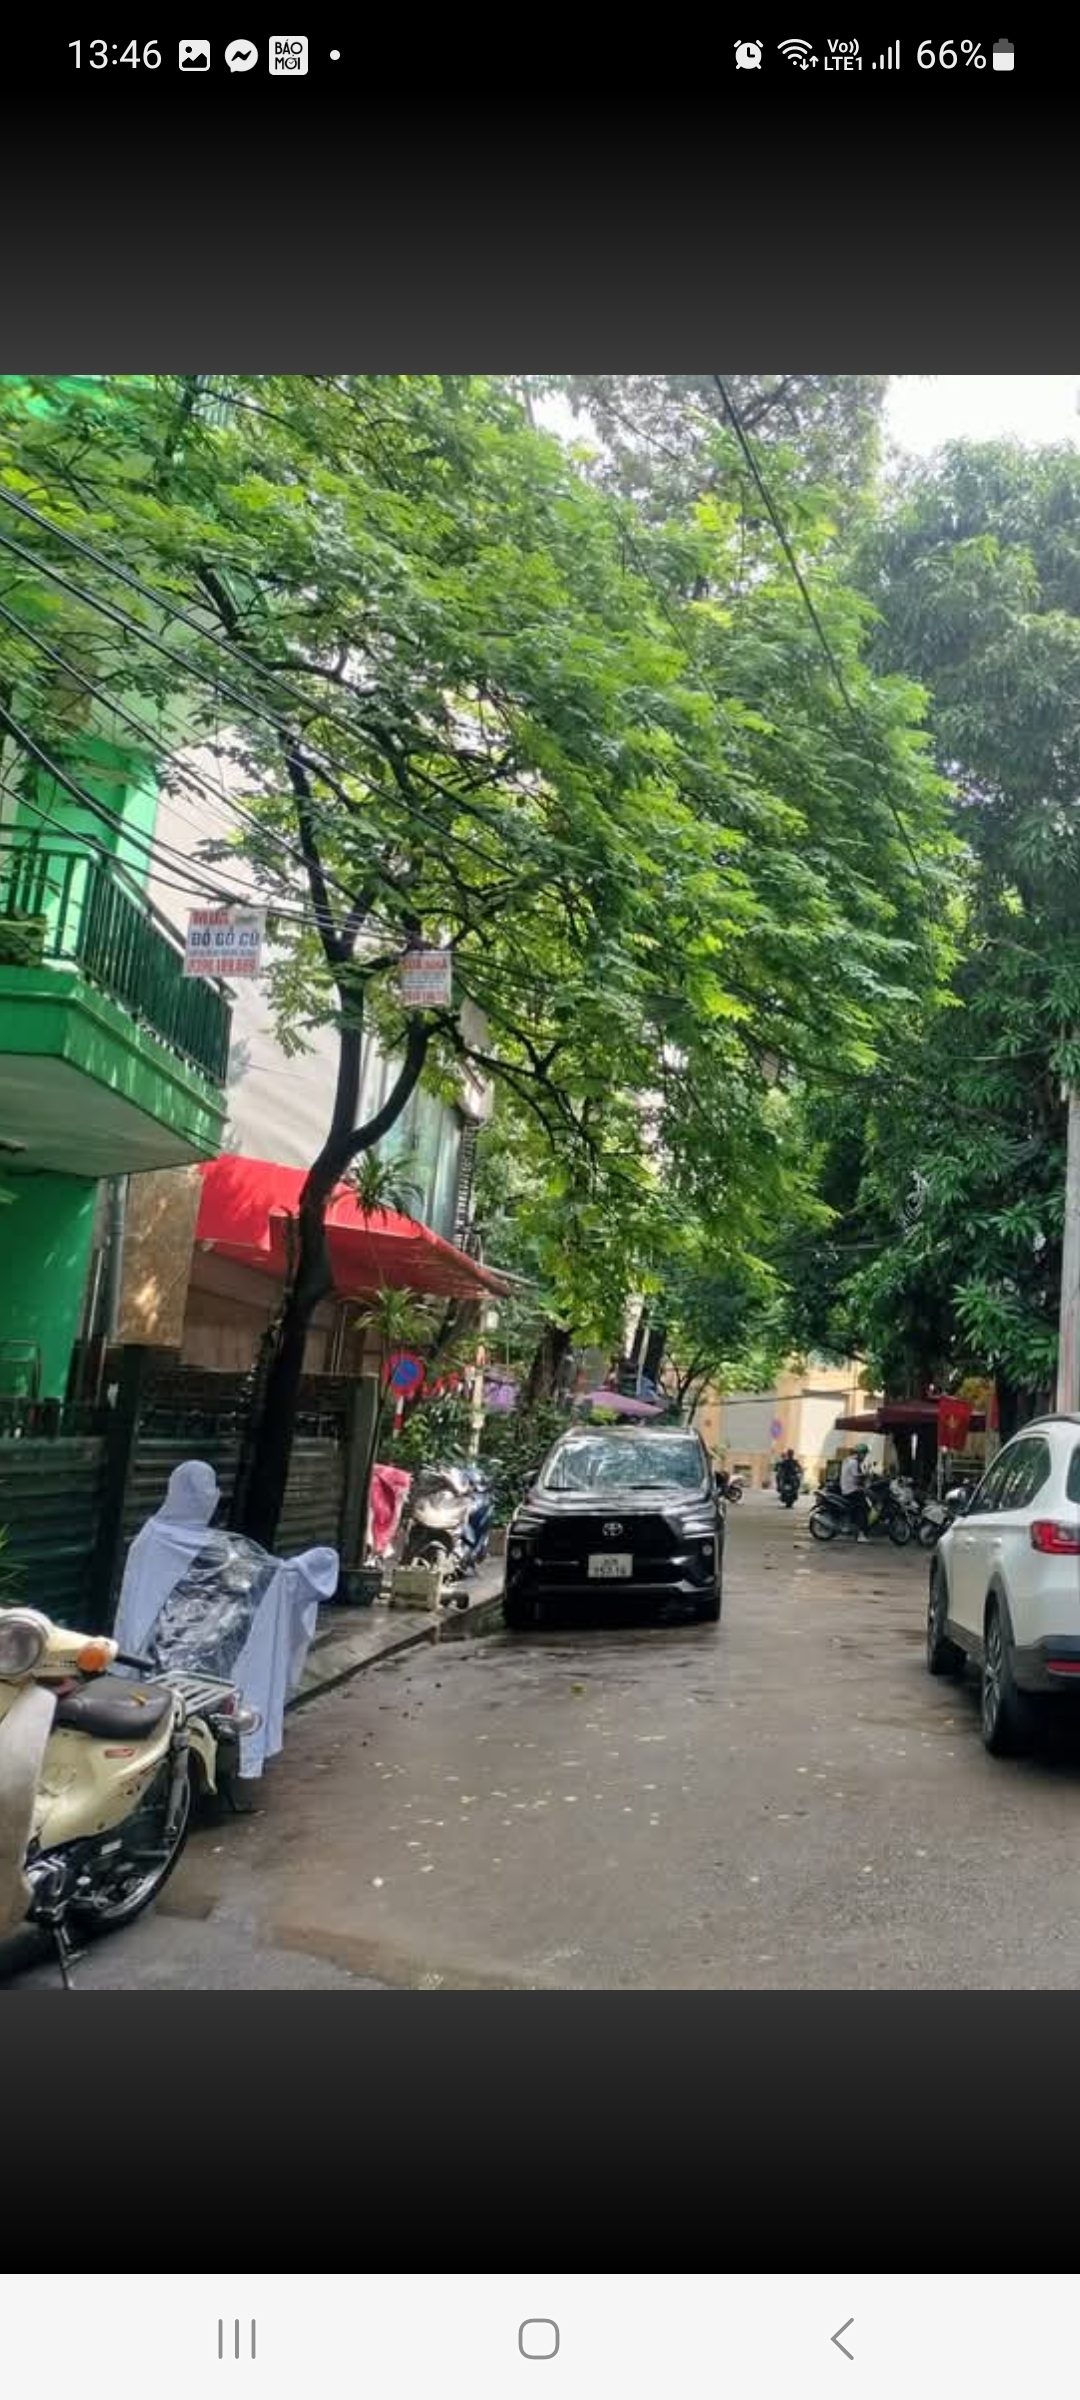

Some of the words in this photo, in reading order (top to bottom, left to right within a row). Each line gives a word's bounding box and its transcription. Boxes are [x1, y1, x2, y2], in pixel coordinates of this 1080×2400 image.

[67, 39, 162, 70] 13:46
[275, 39, 303, 55] BÁO
[916, 39, 988, 70] 66%
[823, 56, 862, 71] LTE1
